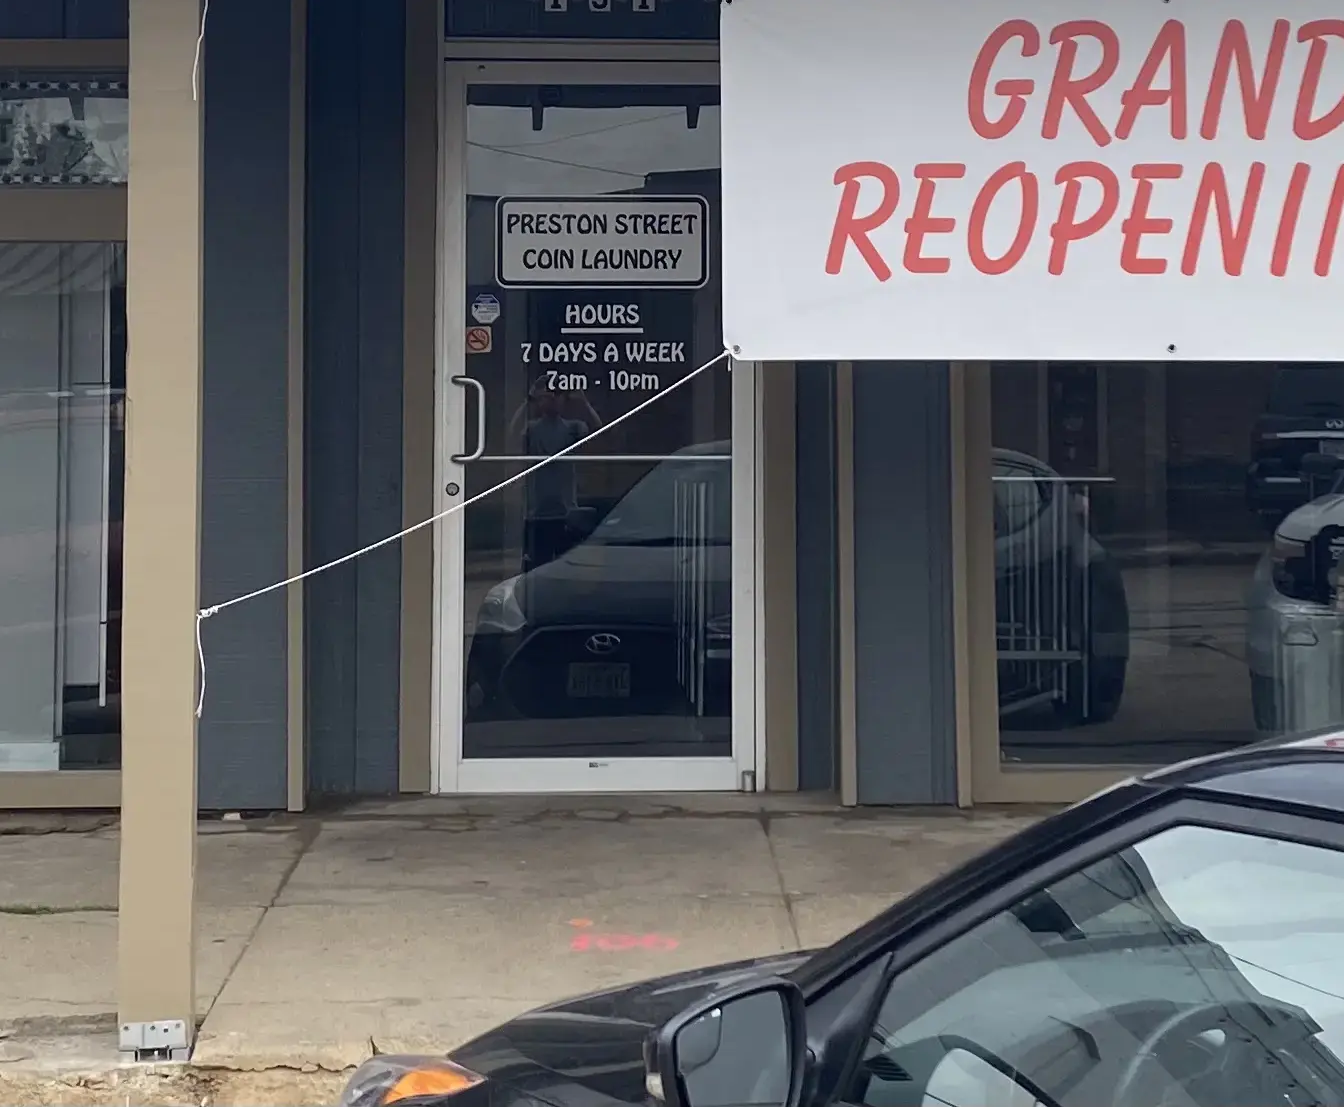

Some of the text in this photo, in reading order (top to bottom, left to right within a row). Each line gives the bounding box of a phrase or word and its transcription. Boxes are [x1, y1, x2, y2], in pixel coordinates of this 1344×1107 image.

[506, 213, 698, 235] PRESTON STREET
[522, 248, 683, 270] COIN LAUNDRY
[565, 304, 640, 325] HOURS
[520, 342, 685, 363] 7 DAYS A WEEK
[546, 370, 587, 391] 7am
[608, 370, 660, 394] 10pm
